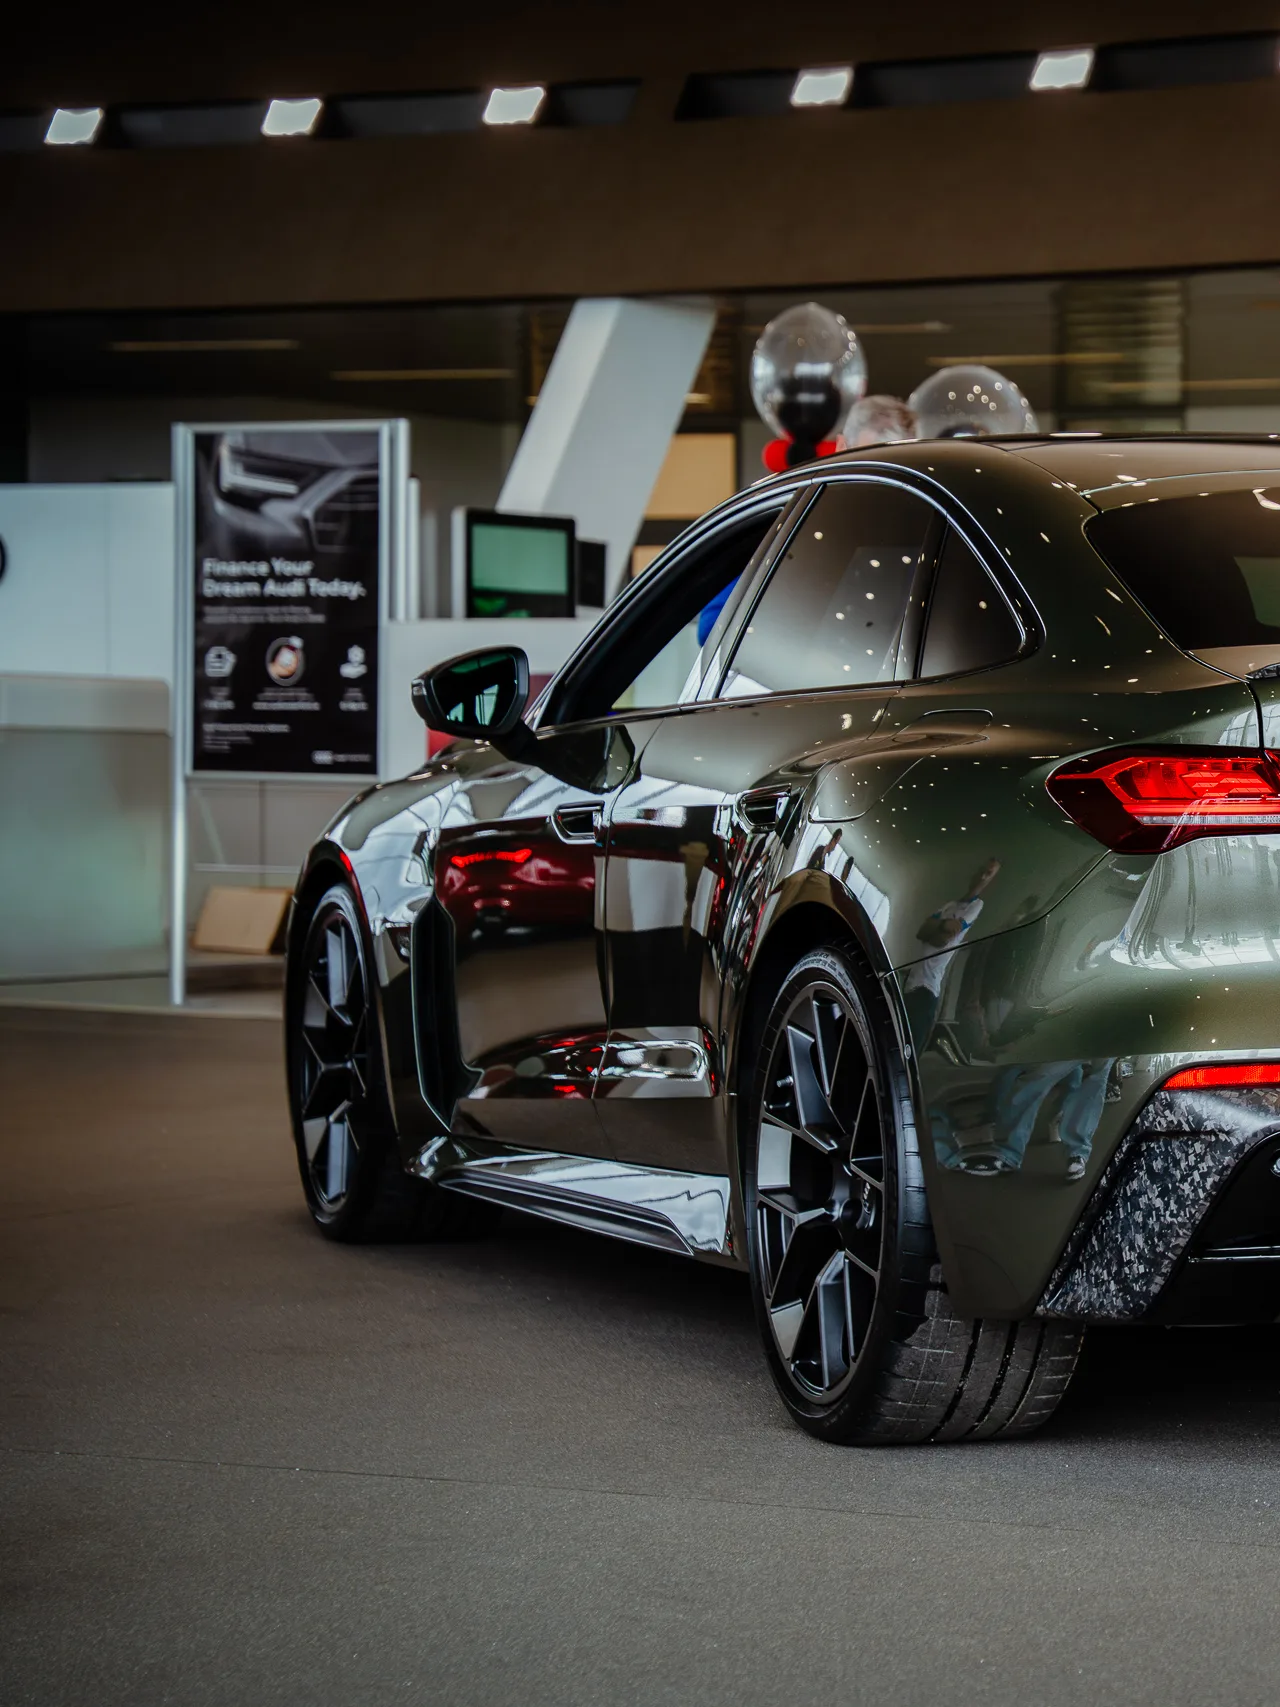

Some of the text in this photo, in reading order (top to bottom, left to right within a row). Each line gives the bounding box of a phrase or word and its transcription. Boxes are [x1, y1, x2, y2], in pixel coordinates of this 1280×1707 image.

[203, 556, 315, 577] Finance Your
[203, 577, 367, 600] Dream Audi Today.
